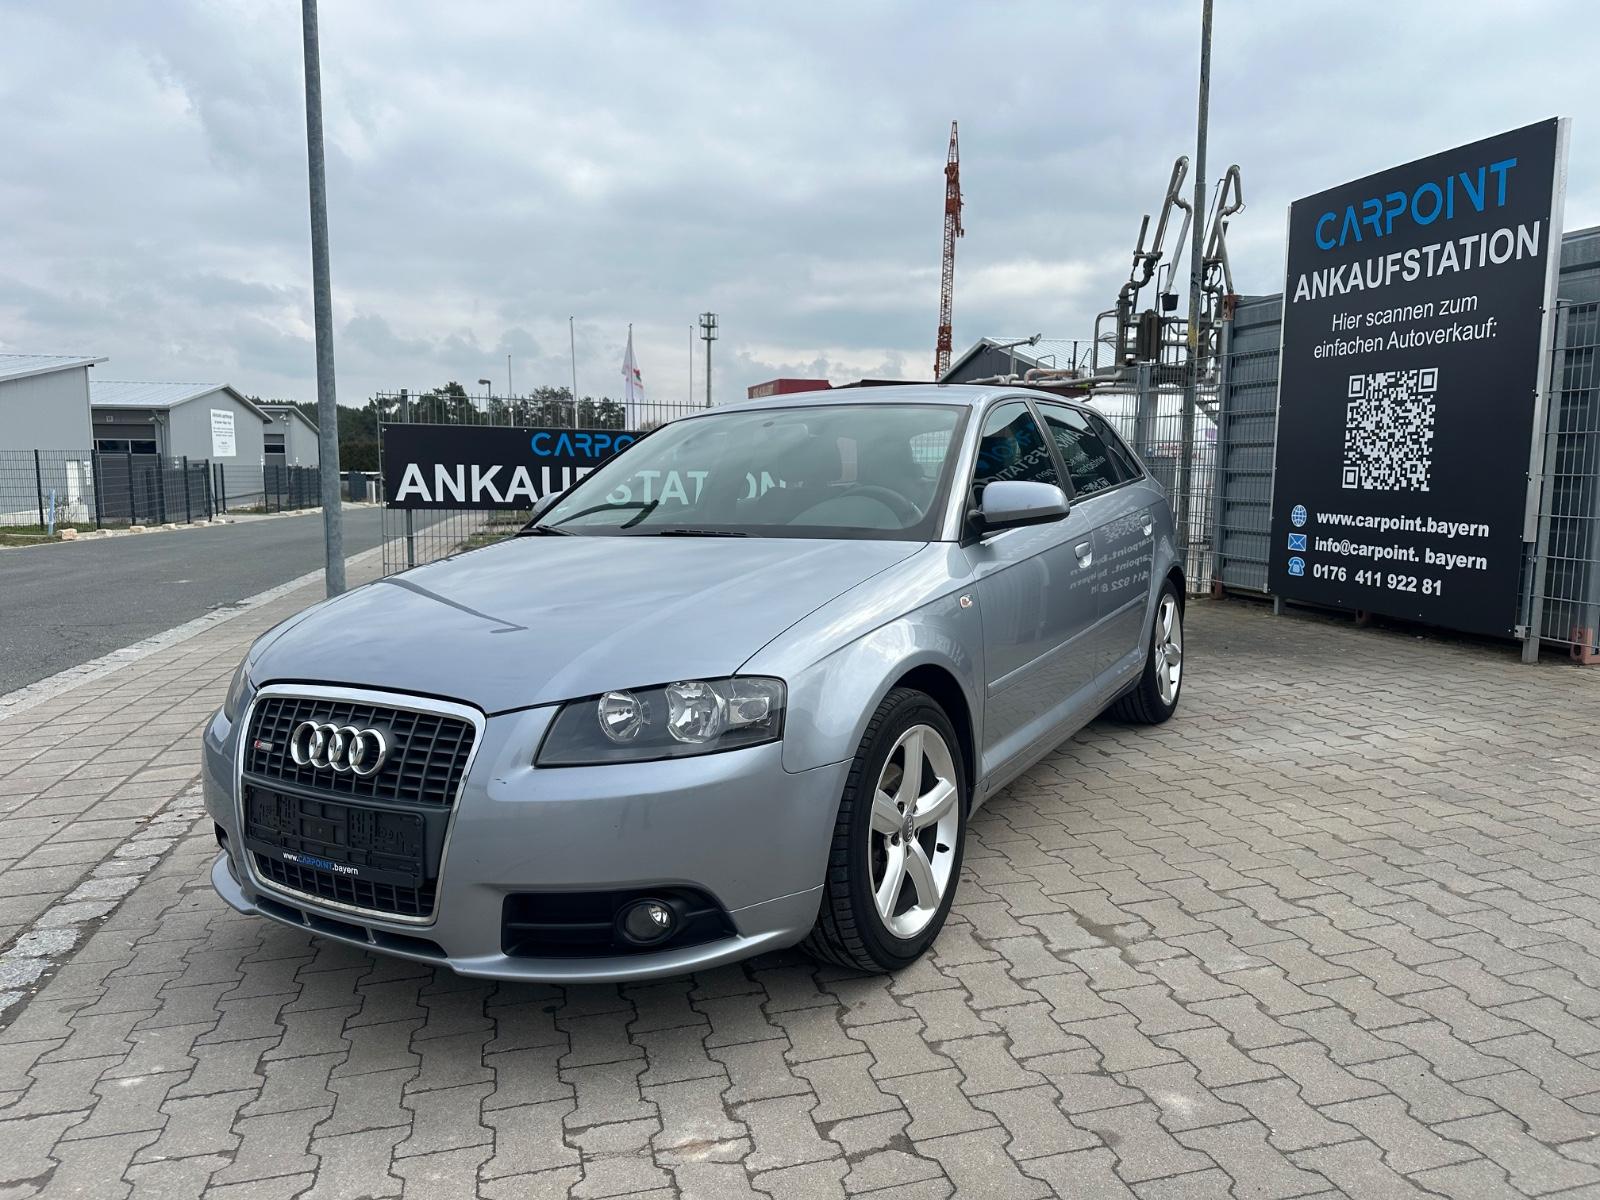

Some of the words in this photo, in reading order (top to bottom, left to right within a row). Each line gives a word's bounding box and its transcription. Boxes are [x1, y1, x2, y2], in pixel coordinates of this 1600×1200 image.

[1315, 157, 1517, 250] CARPOINT
[1293, 221, 1541, 303] ANKAUFSTATION
[1332, 313, 1362, 332] Hier
[1366, 302, 1434, 327] scannen
[1439, 295, 1478, 315] zum
[1314, 334, 1383, 359] einfachen
[1387, 316, 1498, 350] Autoverkauf:
[1317, 512, 1490, 538] www.carpoint.bayern
[1314, 536, 1419, 562] info@carpoint.
[1425, 547, 1488, 571] bayern
[1313, 563, 1347, 582] 0176
[1354, 569, 1381, 587] 411
[1387, 573, 1417, 593] 922
[1421, 578, 1443, 596] 81
